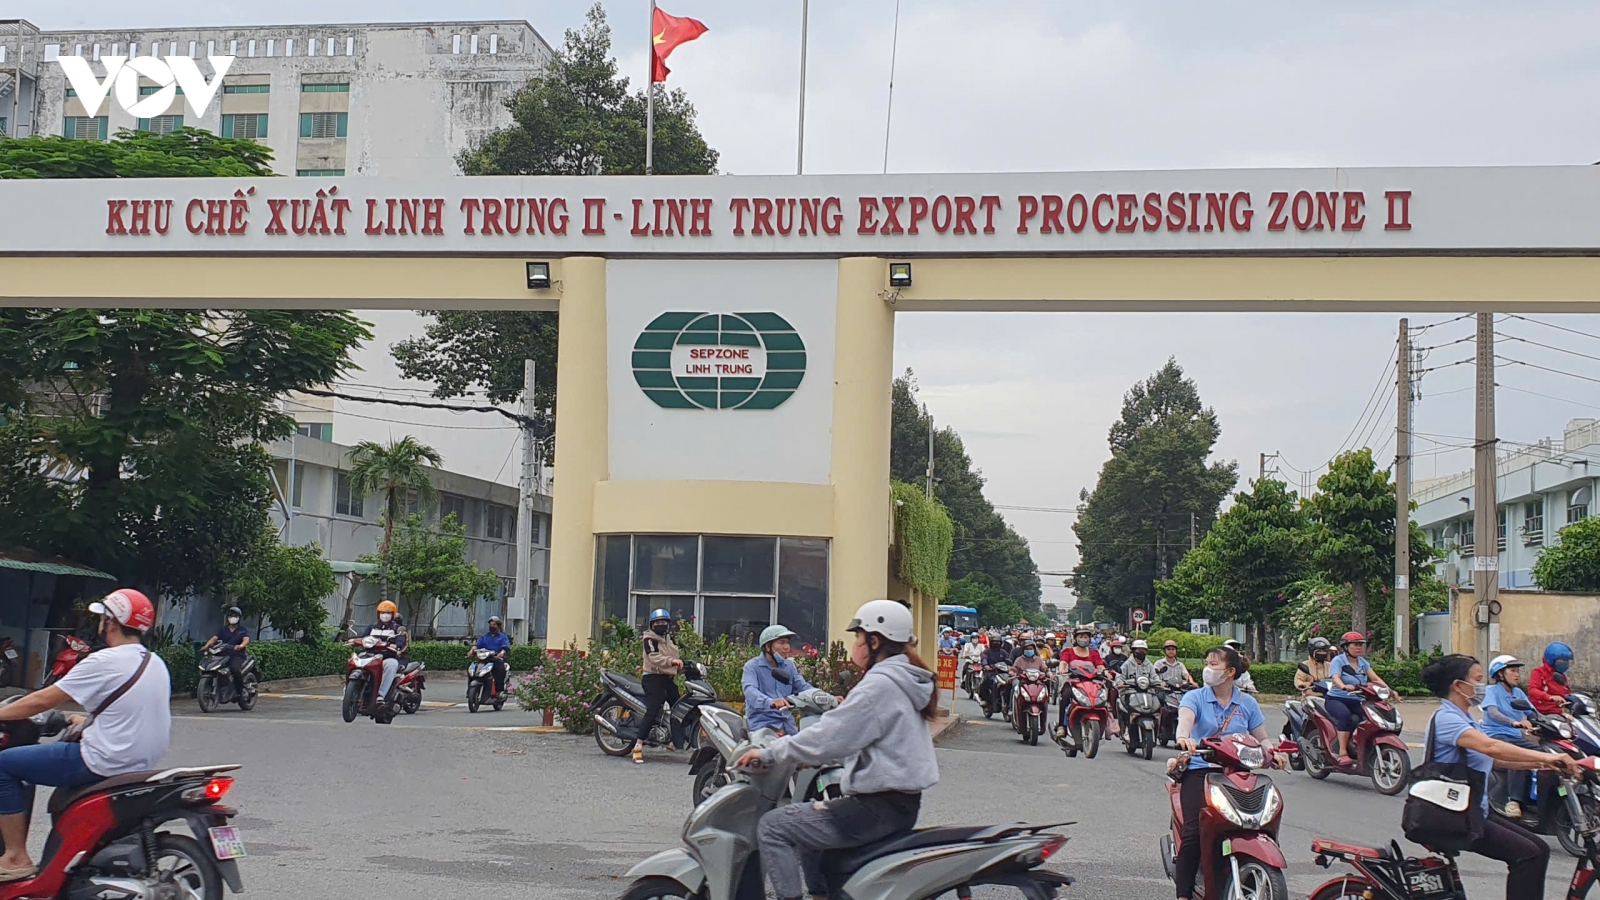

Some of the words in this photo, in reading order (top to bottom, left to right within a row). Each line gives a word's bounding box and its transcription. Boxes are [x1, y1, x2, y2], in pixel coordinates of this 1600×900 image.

[106, 200, 173, 235] KHU
[186, 187, 256, 235] CHẾ
[266, 187, 351, 235] XUẤT
[365, 199, 445, 235] LINH
[462, 199, 570, 235] TRUNG
[632, 199, 713, 236] LINH
[732, 198, 843, 236] TRUNG
[858, 196, 1001, 235] EXPORT
[1018, 192, 1254, 234] PROCESSING
[1268, 191, 1365, 231] ZONE
[690, 349, 749, 359] SEPZONE
[686, 364, 711, 374] LINH
[714, 364, 752, 374] TRUNG
